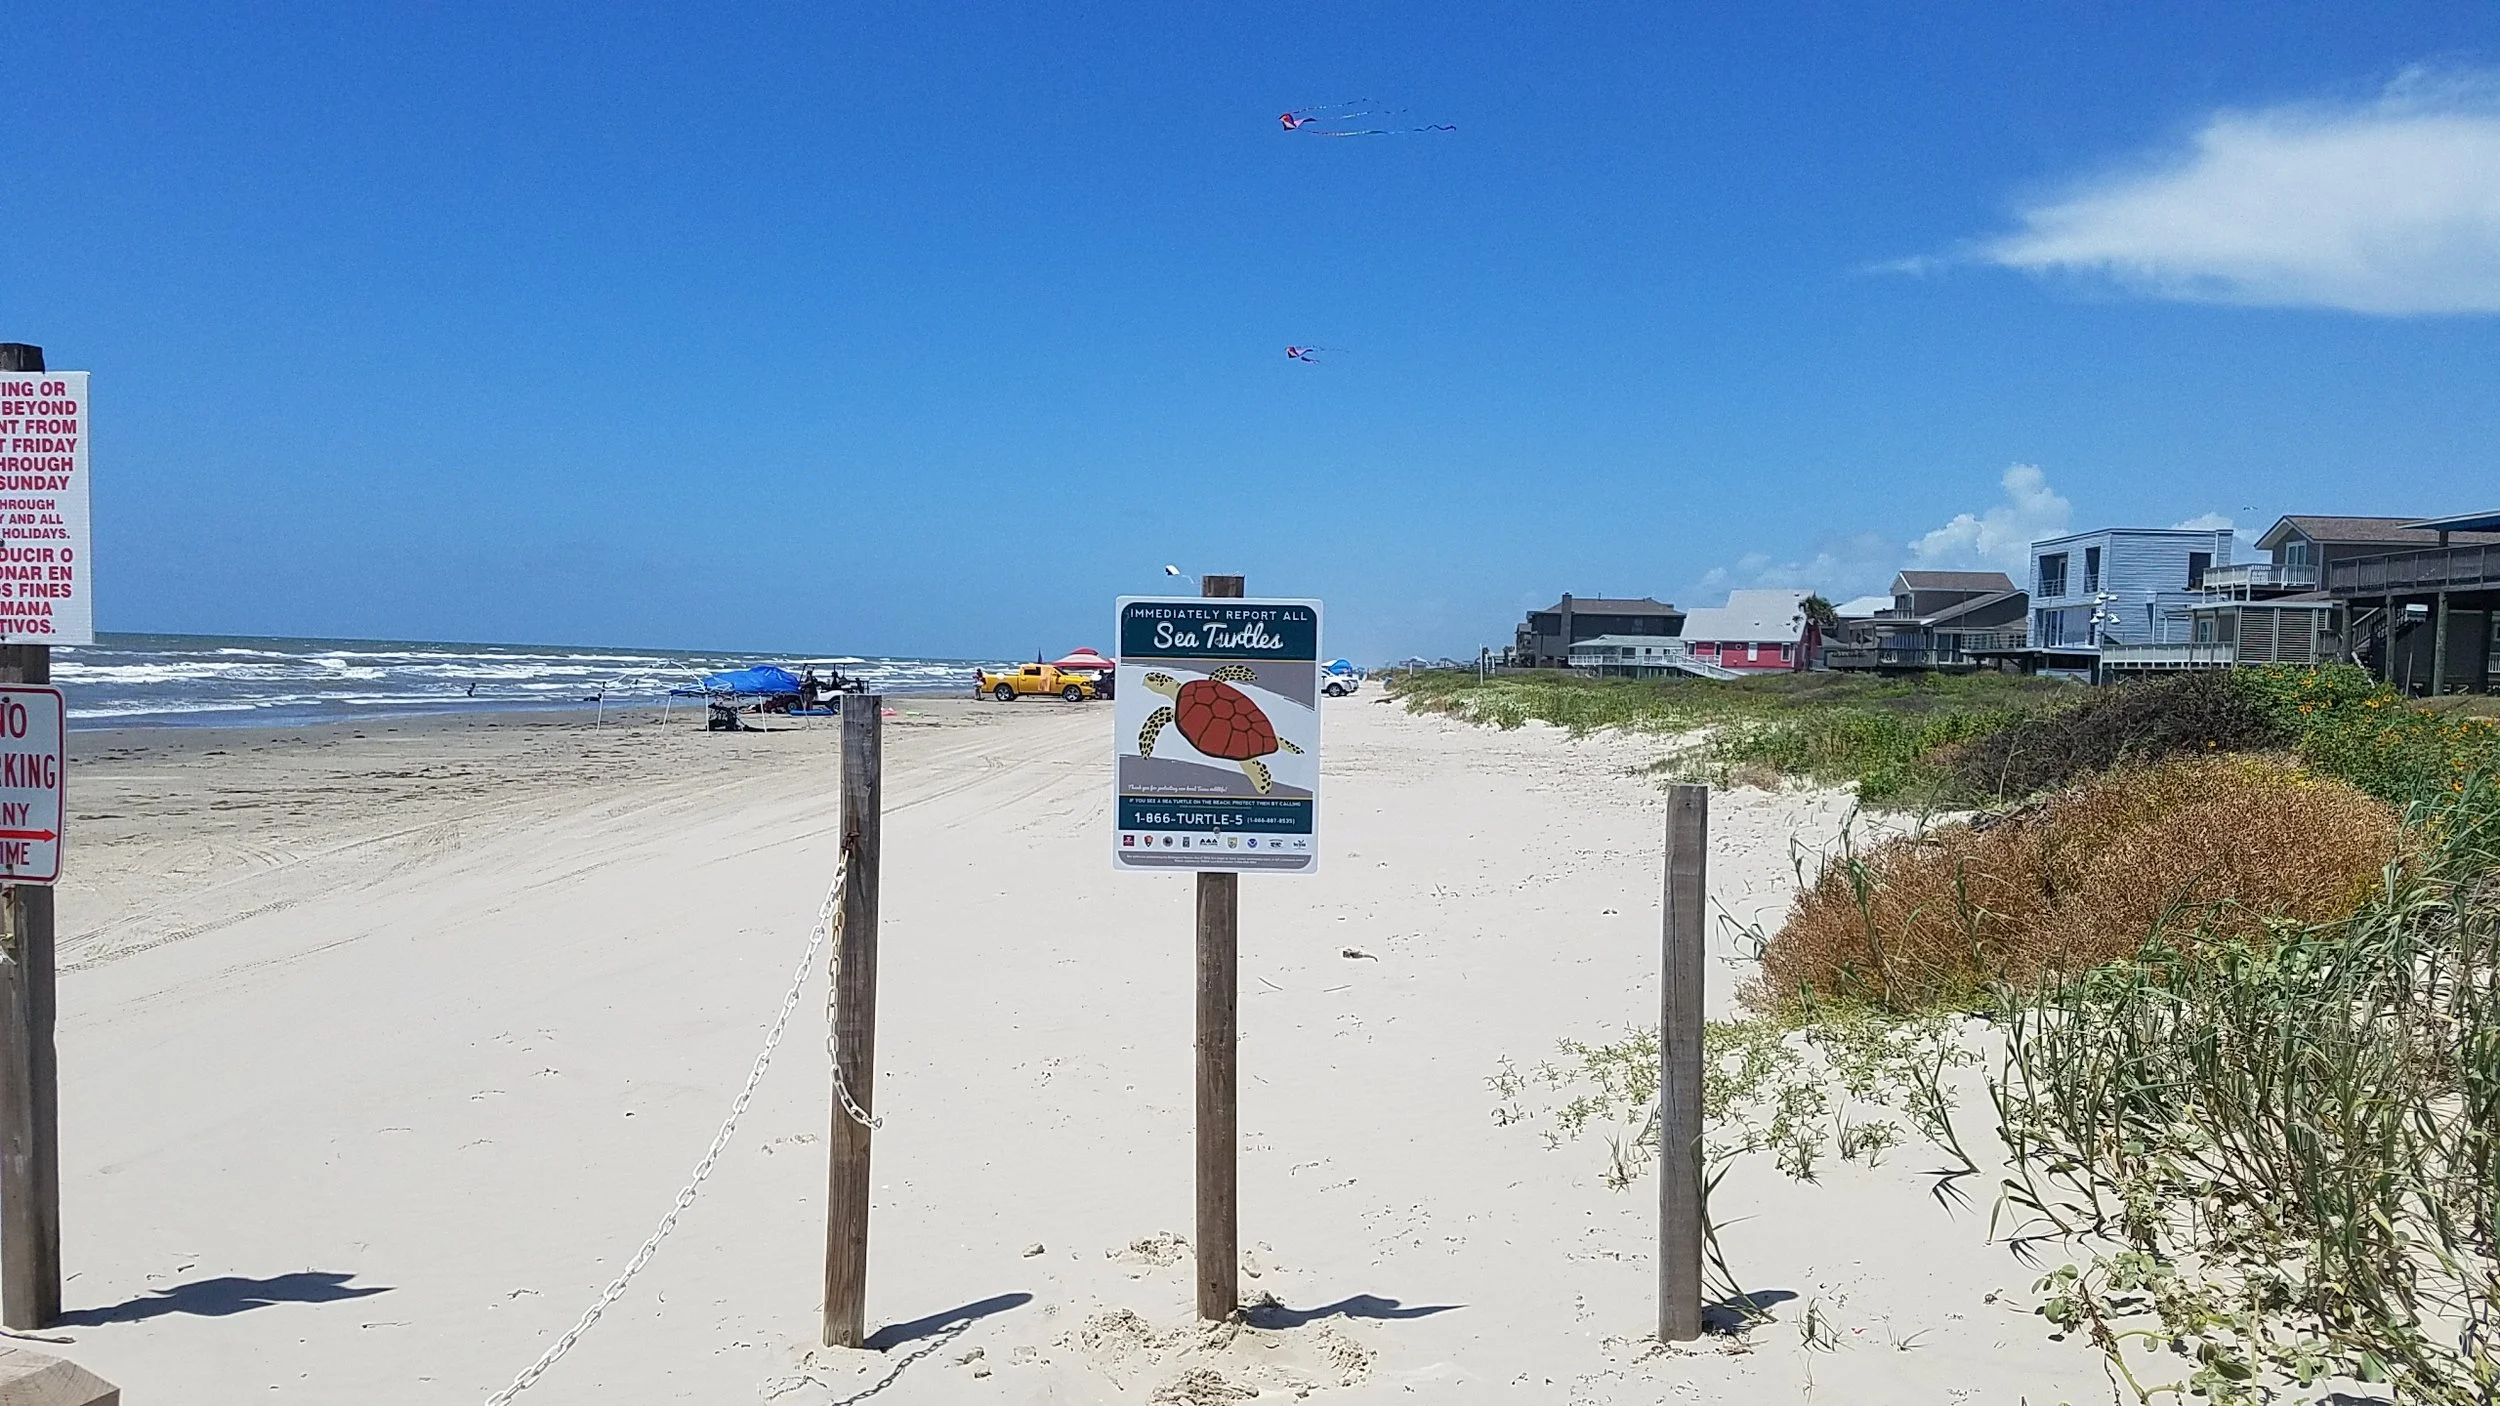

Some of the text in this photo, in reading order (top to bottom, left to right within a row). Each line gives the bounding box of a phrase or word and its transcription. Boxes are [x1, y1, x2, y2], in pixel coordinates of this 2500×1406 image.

[0, 382, 66, 397] ING OR
[2, 401, 77, 416] BEYOND
[25, 420, 77, 434] FROM
[12, 438, 78, 453] FRIDAY
[9, 514, 36, 525] AND
[40, 514, 64, 525] ALL
[2, 528, 71, 540] HOLIDAYS.
[60, 548, 74, 563] O
[0, 565, 73, 581] NAR EN
[0, 583, 72, 598] S FINES
[1130, 608, 1308, 621] IMMEDIATELY REPORT ALL
[0, 619, 56, 634] TIVOS.
[1153, 620, 1284, 649] Sea Turtles
[0, 753, 56, 789] KING
[0, 803, 30, 827] NY
[1135, 812, 1243, 825] 1-866-TURTLE-5
